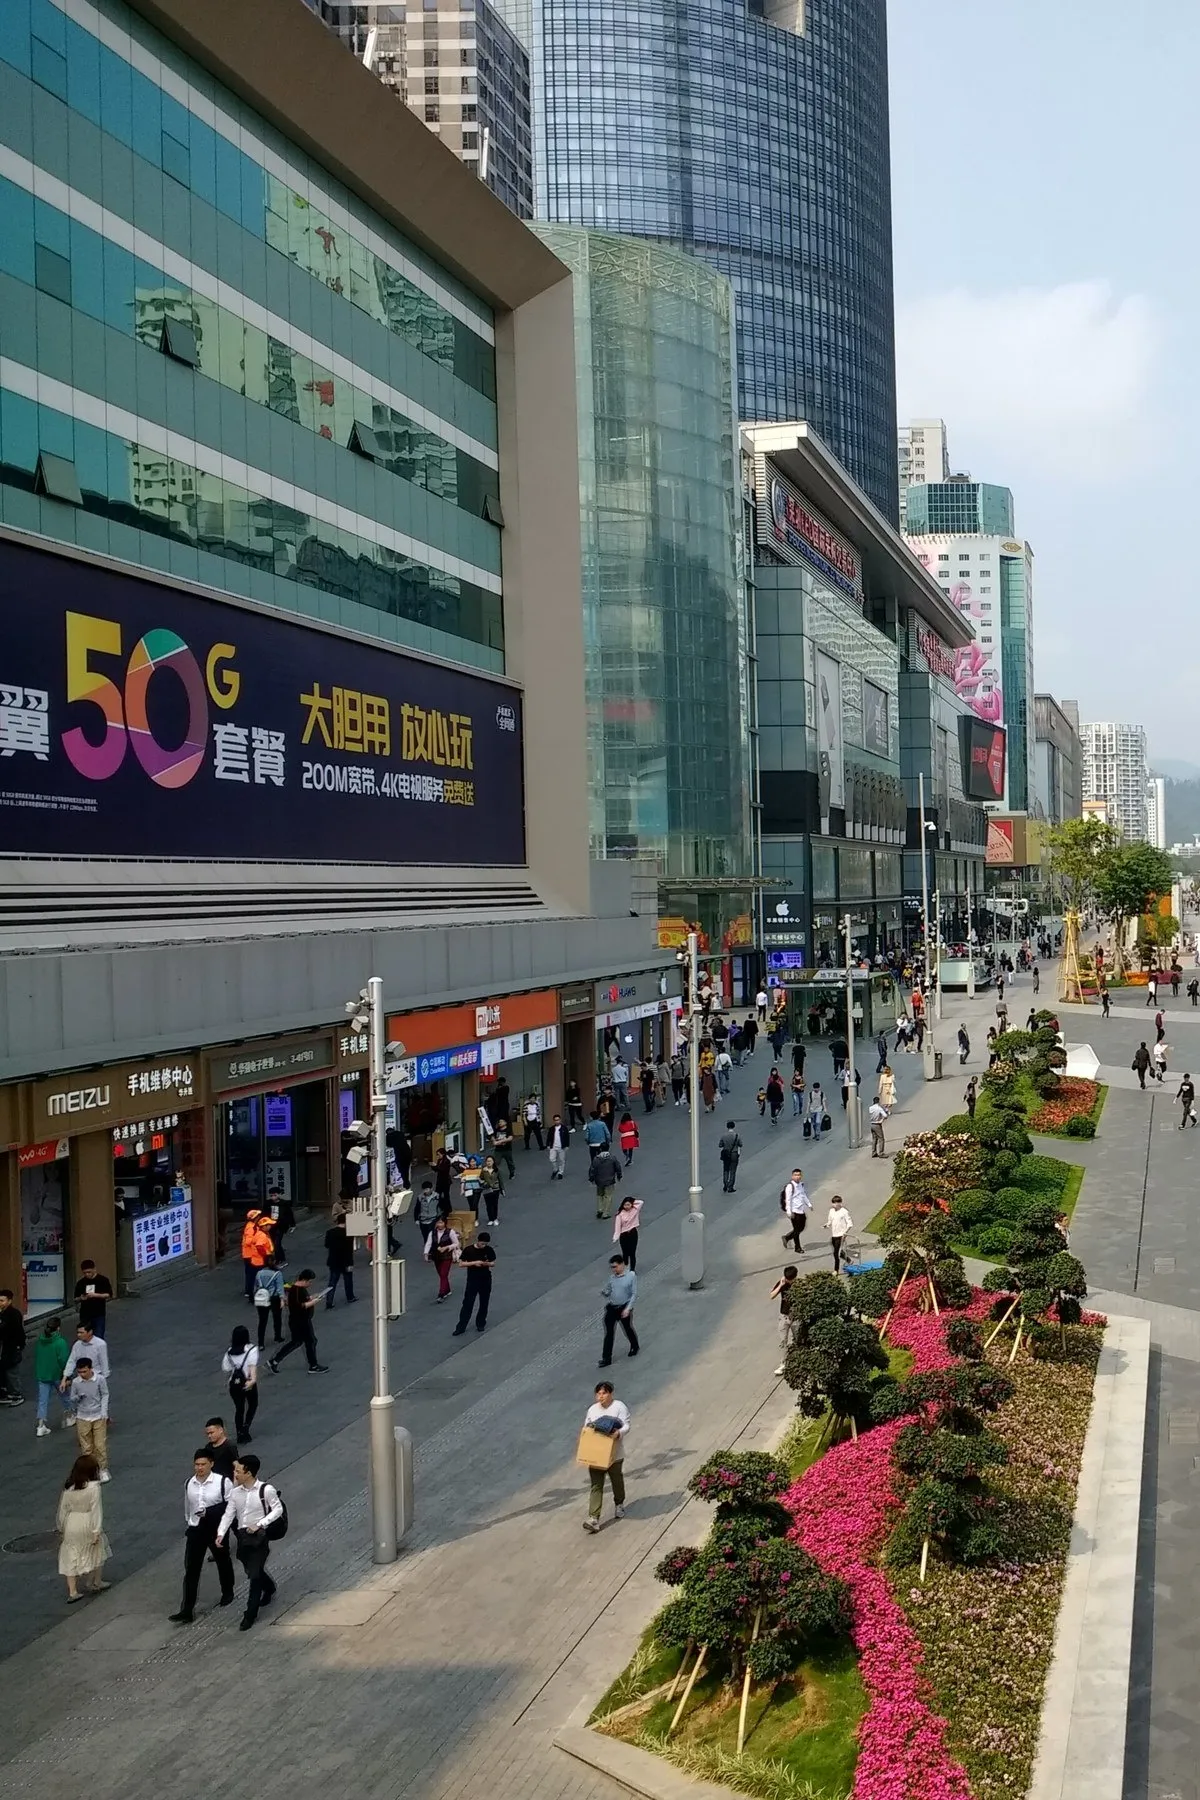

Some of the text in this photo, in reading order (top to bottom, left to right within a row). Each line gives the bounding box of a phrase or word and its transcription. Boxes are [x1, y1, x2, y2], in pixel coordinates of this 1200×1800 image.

[0, 683, 50, 762] 翼
[300, 682, 473, 771] 大胆用 放心玩
[212, 722, 286, 787] 套餐
[127, 1065, 193, 1097] 手机维修中心
[47, 1084, 110, 1117] MEIZU
[112, 1114, 179, 1141] 快速换屏 专业维修
[136, 1207, 190, 1236] 苹果专业维修中心
